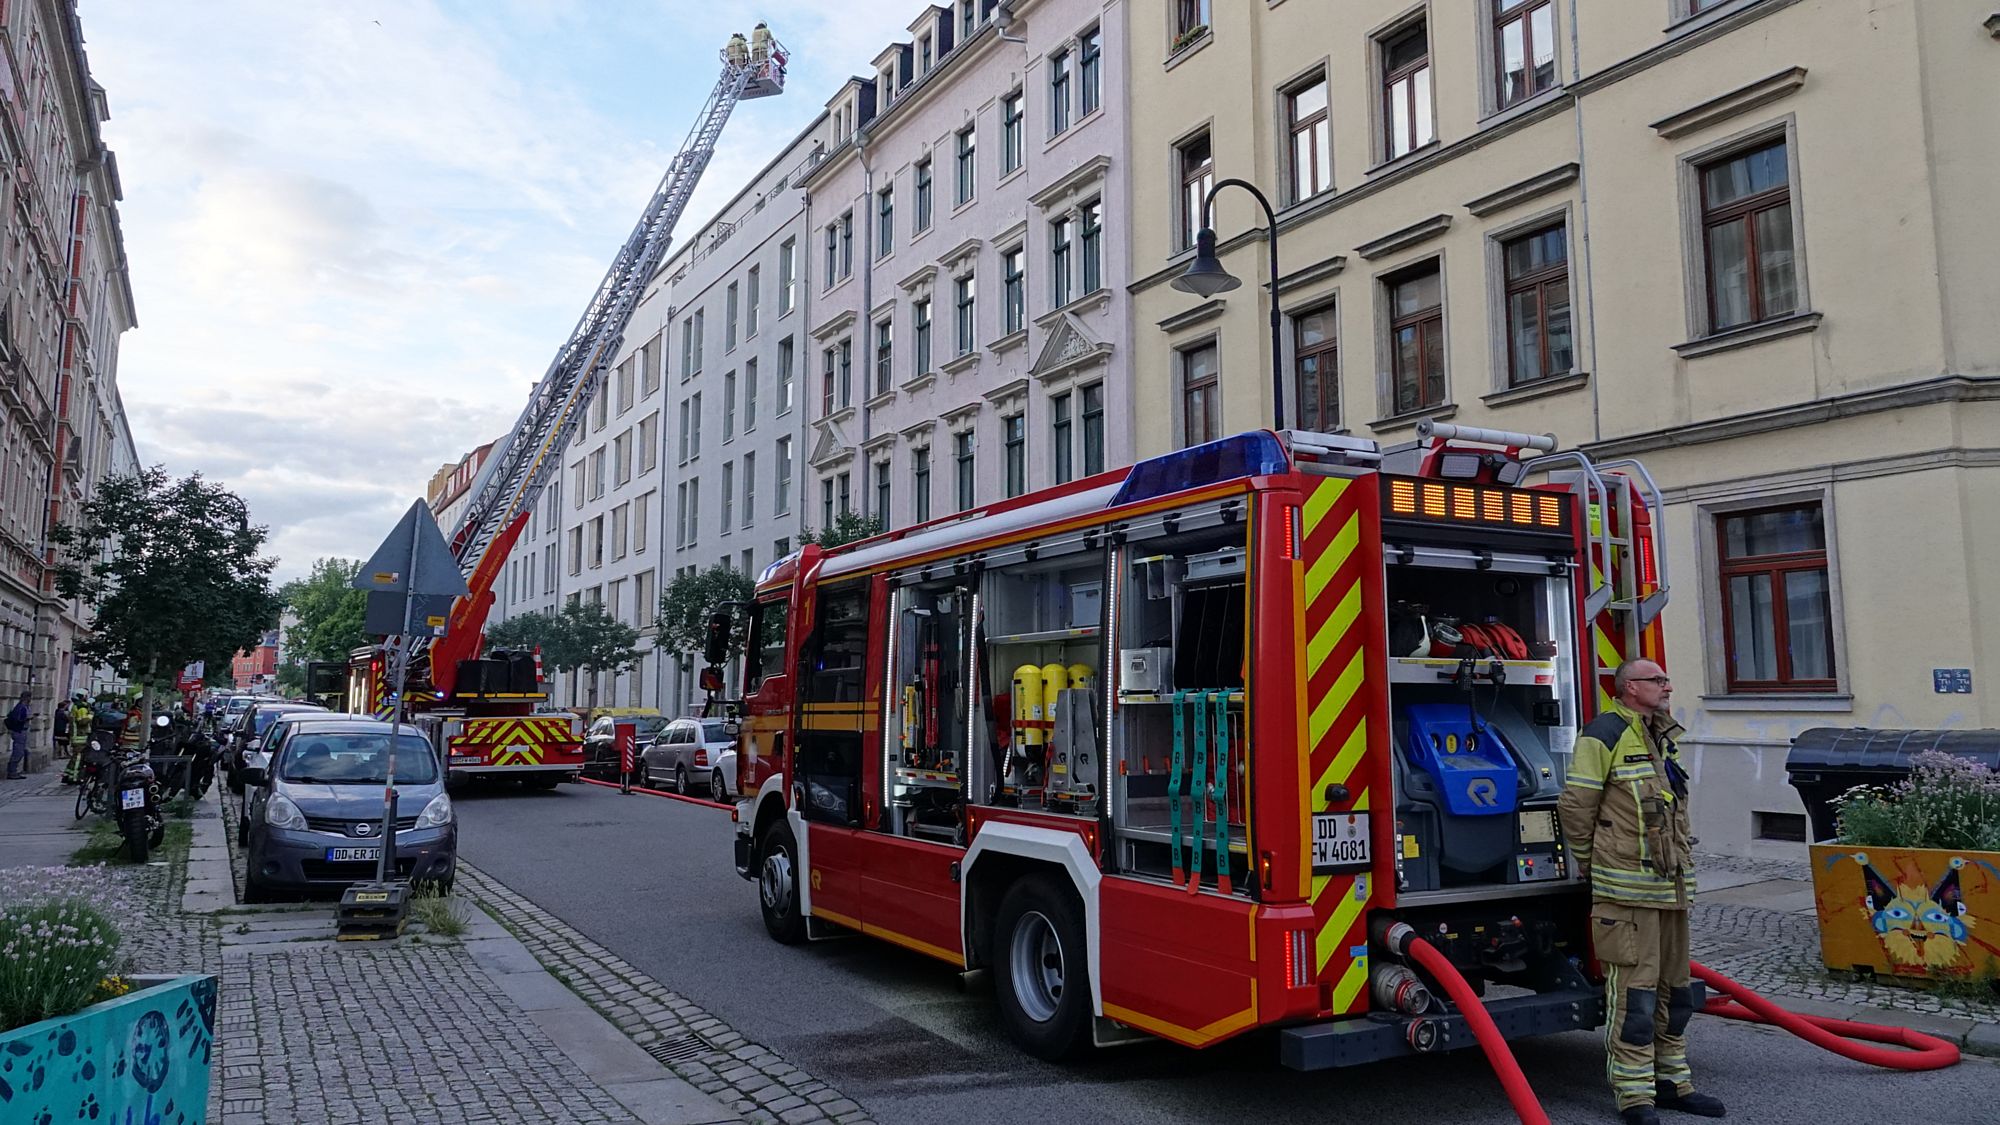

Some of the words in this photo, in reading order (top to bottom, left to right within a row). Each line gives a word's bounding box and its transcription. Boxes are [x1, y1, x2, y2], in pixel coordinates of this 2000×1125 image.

[804, 597, 811, 625] 1
[1318, 819, 1337, 839] DD
[334, 849, 348, 860] DD
[353, 849, 367, 859] ER
[1331, 840, 1367, 861] 4081
